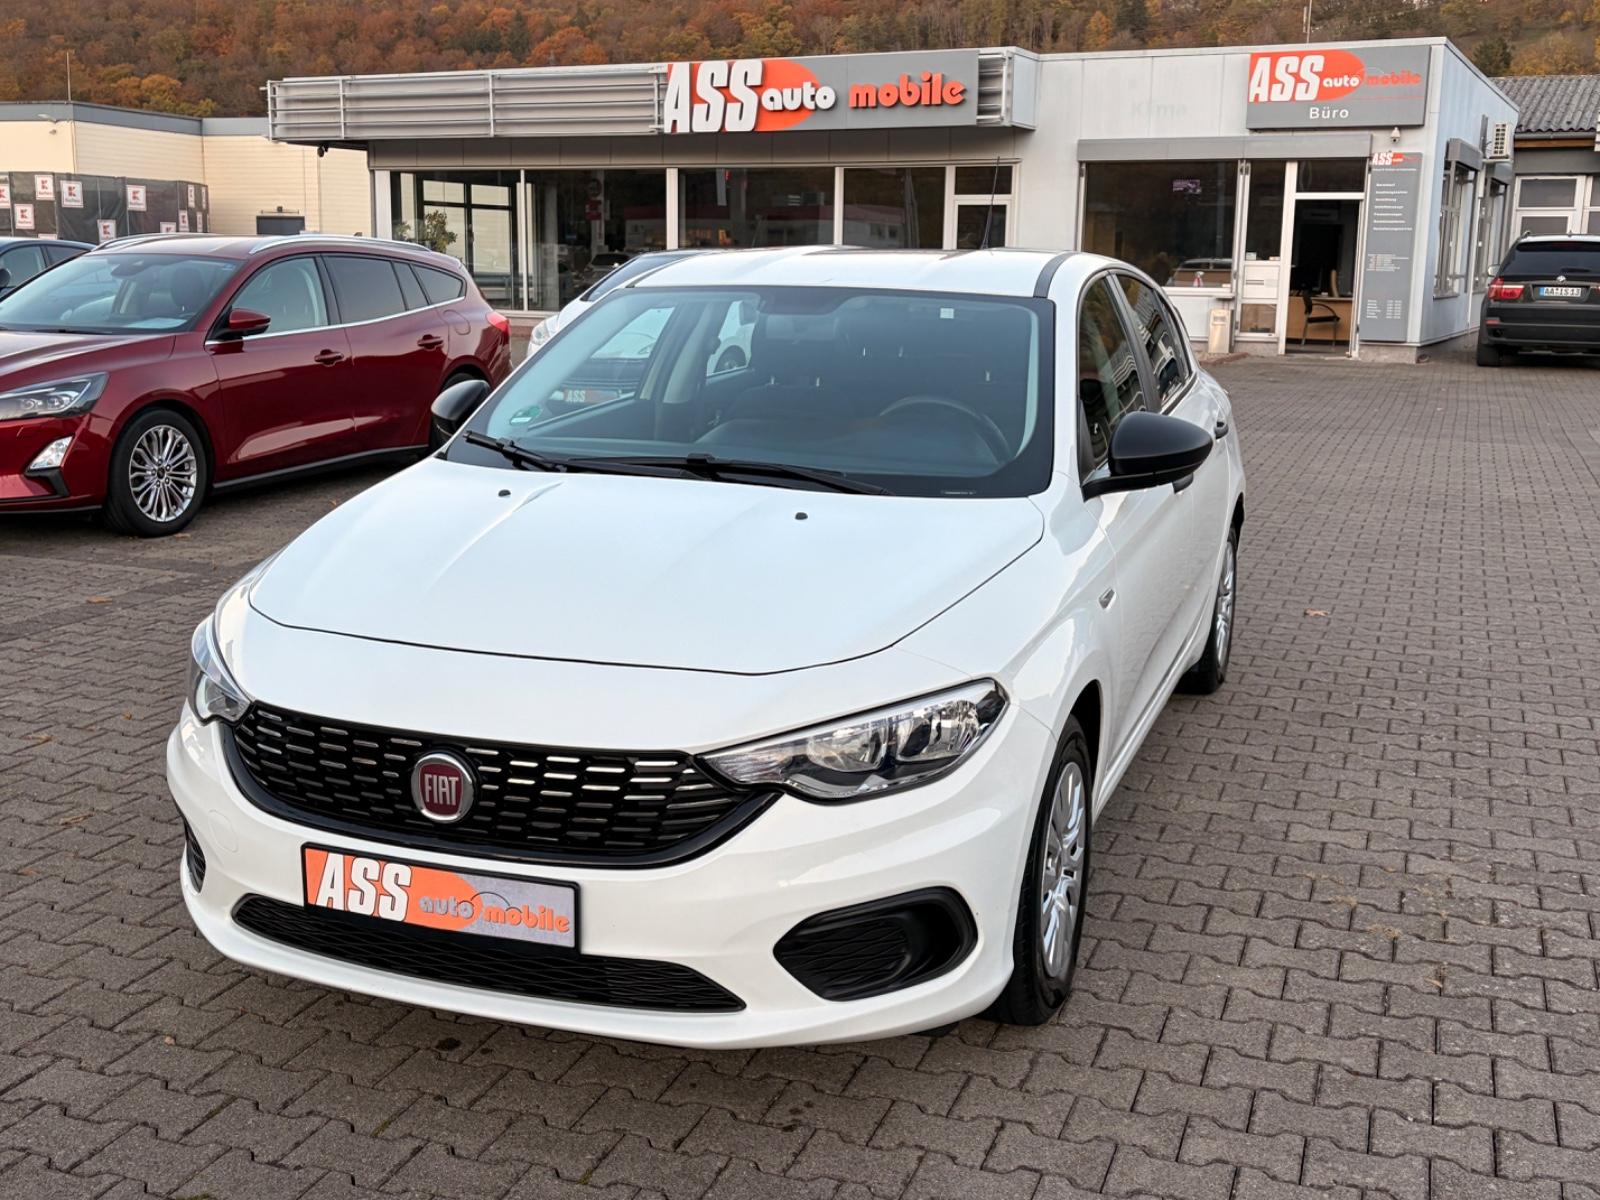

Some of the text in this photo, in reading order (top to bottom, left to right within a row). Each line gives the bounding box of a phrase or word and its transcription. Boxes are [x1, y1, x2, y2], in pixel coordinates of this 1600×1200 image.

[1249, 55, 1325, 102] ASS
[1323, 74, 1360, 88] auto
[663, 60, 967, 134] ASS auto mobile
[1309, 106, 1349, 119] Büro
[1372, 152, 1394, 166] ASS
[567, 390, 586, 403] ASS
[424, 774, 459, 806] FIAT
[315, 852, 570, 932] ASS auto mobile
